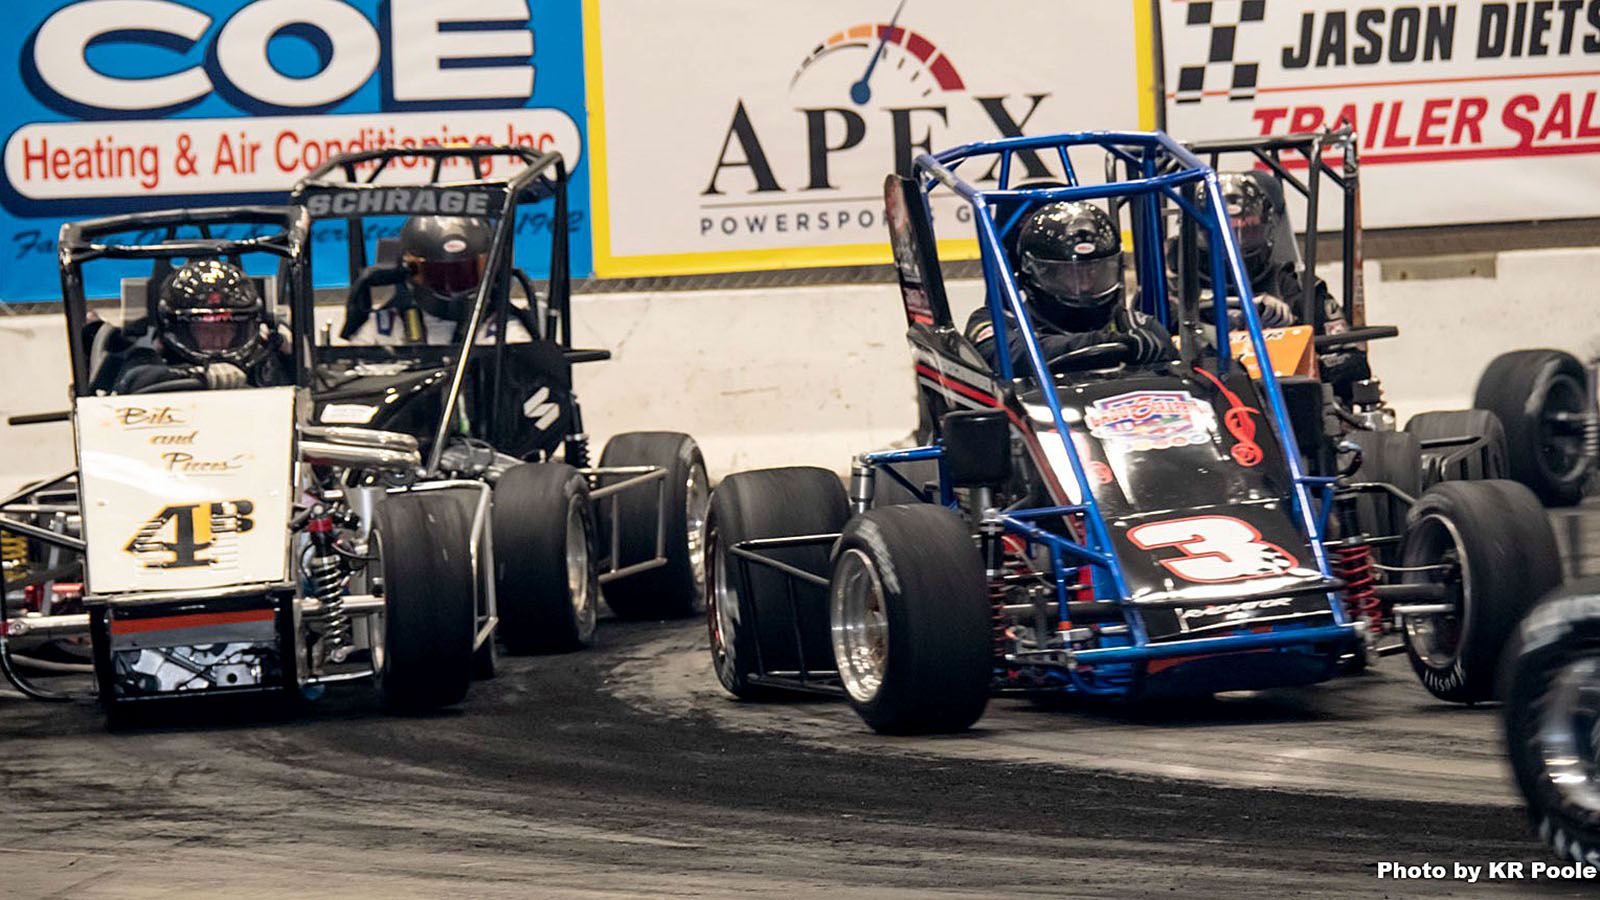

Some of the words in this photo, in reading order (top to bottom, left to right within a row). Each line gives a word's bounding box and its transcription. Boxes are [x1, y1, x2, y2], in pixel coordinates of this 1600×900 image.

[28, 0, 535, 115] COE
[1281, 5, 1457, 69] JASON
[700, 92, 1056, 196] APEX
[1252, 96, 1489, 154] TRAILER
[23, 138, 160, 189] Heating
[175, 135, 199, 177] &
[213, 130, 262, 175] Air
[305, 188, 490, 218] SCHRAGE
[149, 430, 199, 445] and
[1126, 514, 1299, 584] 3
